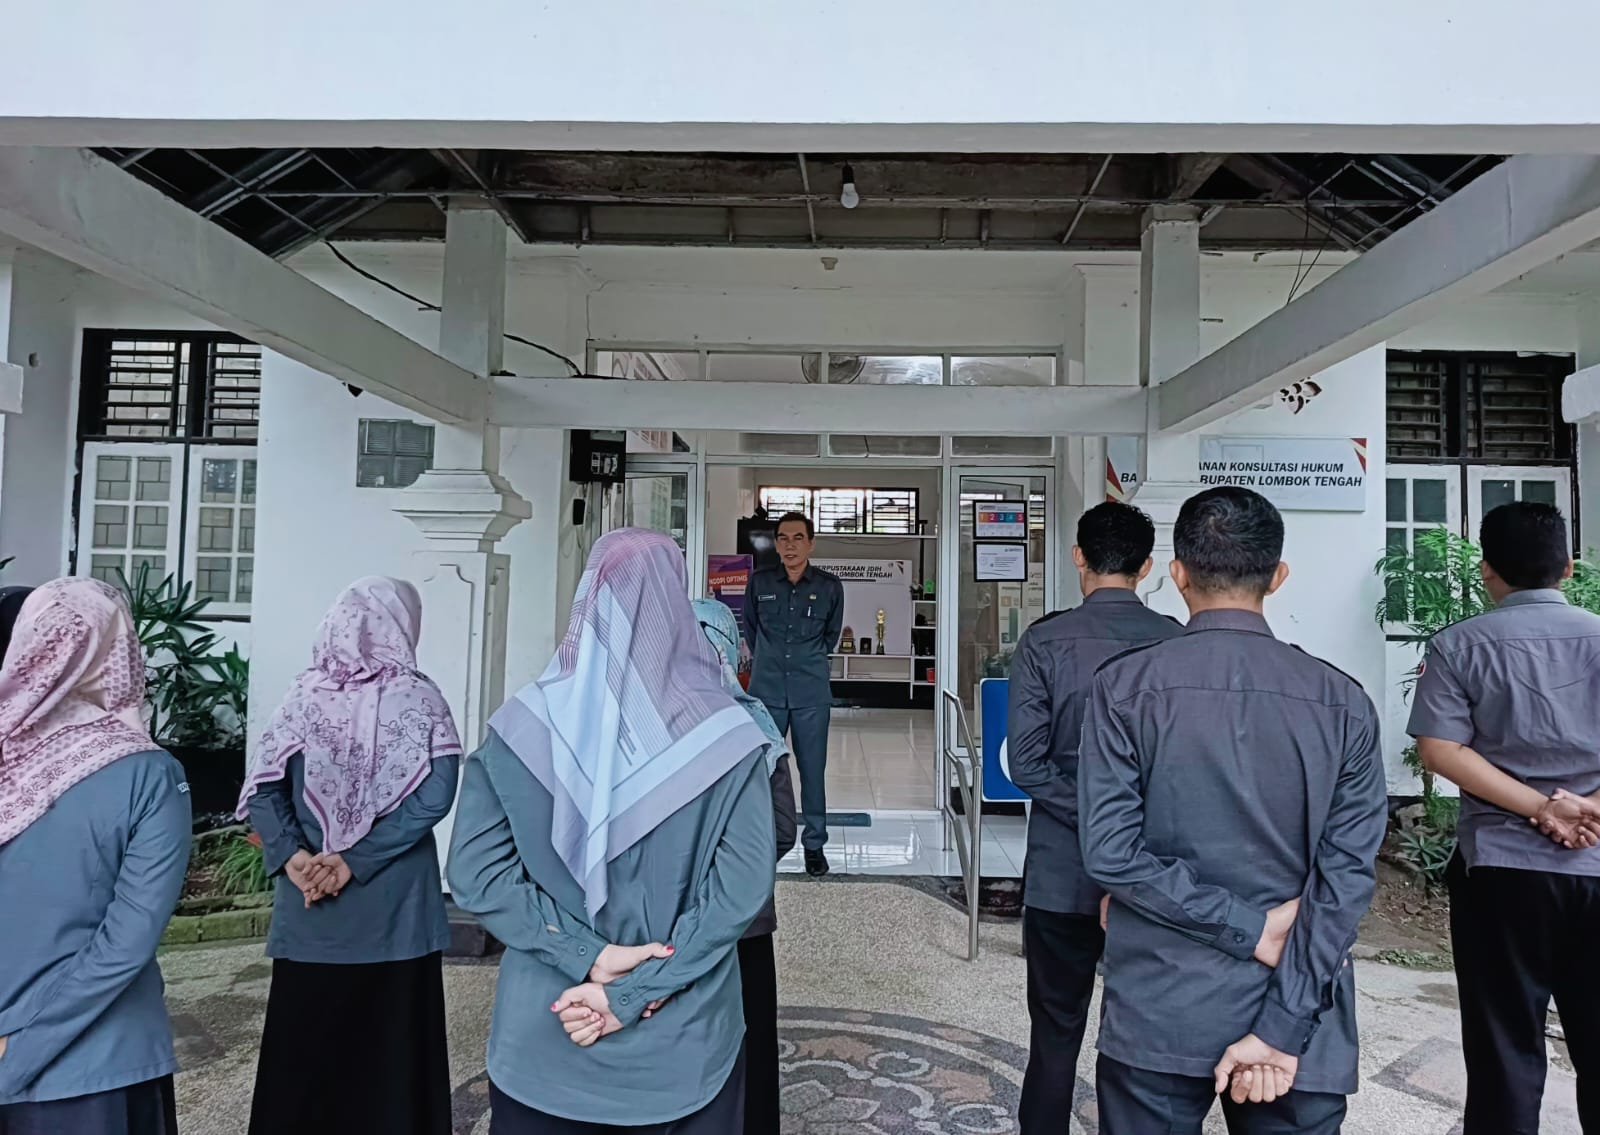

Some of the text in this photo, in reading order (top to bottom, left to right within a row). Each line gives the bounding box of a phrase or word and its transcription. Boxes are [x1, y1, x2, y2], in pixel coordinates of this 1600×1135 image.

[1229, 462, 1298, 472] KONSULTASI
[1300, 463, 1344, 473] HUKUM
[1258, 475, 1312, 486] LOMBOK
[1314, 476, 1363, 487] TENGAH
